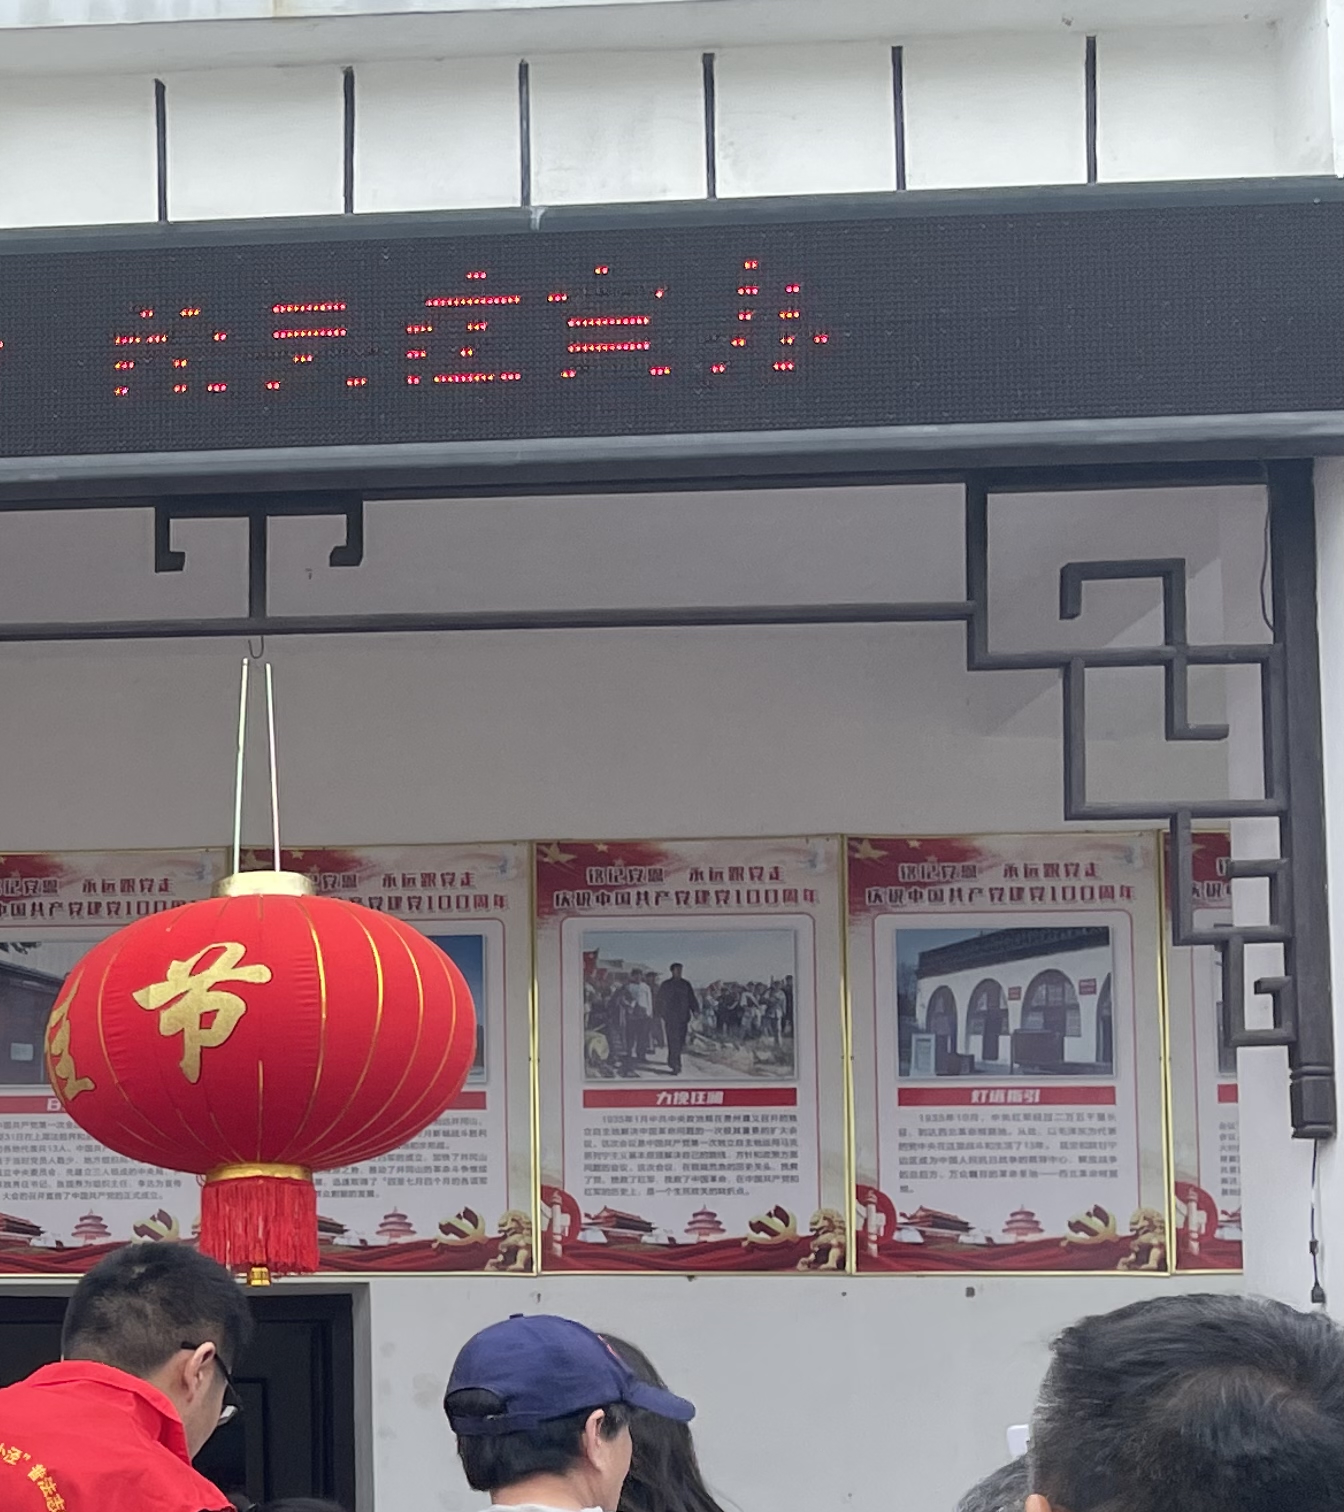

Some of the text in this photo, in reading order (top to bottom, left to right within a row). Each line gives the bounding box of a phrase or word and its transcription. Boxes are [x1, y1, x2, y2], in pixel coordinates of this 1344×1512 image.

[554, 888, 820, 907] 庆祝中国共产党建党100周年
[866, 884, 1137, 905] 庆祝中国共产党建党100周年
